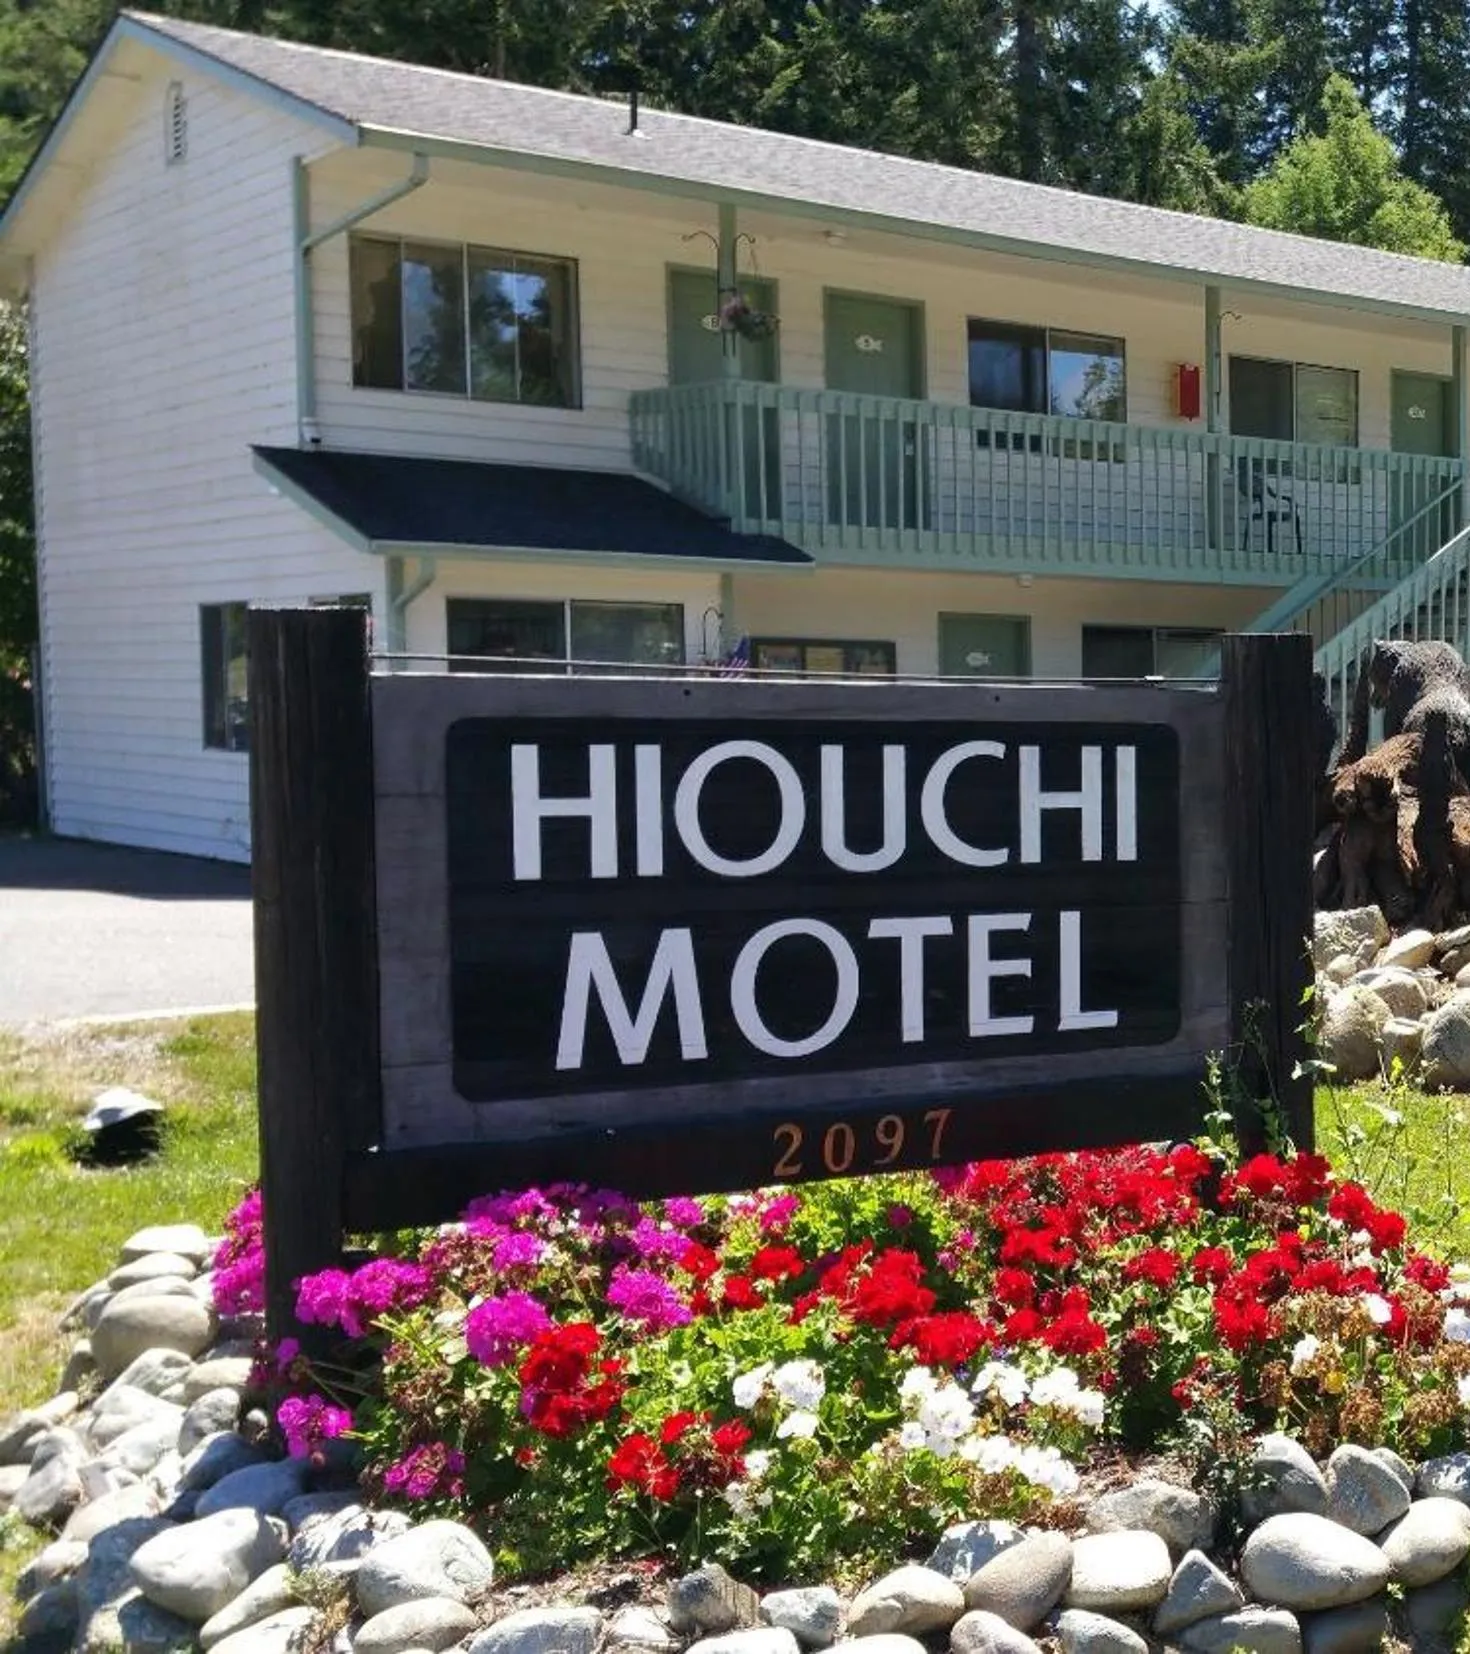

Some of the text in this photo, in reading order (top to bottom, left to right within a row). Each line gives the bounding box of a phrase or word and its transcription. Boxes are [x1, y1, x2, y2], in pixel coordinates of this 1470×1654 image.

[511, 740, 1137, 880] HIOUCHI
[556, 910, 1118, 1070] MOTEL
[773, 1108, 954, 1177] 2097
